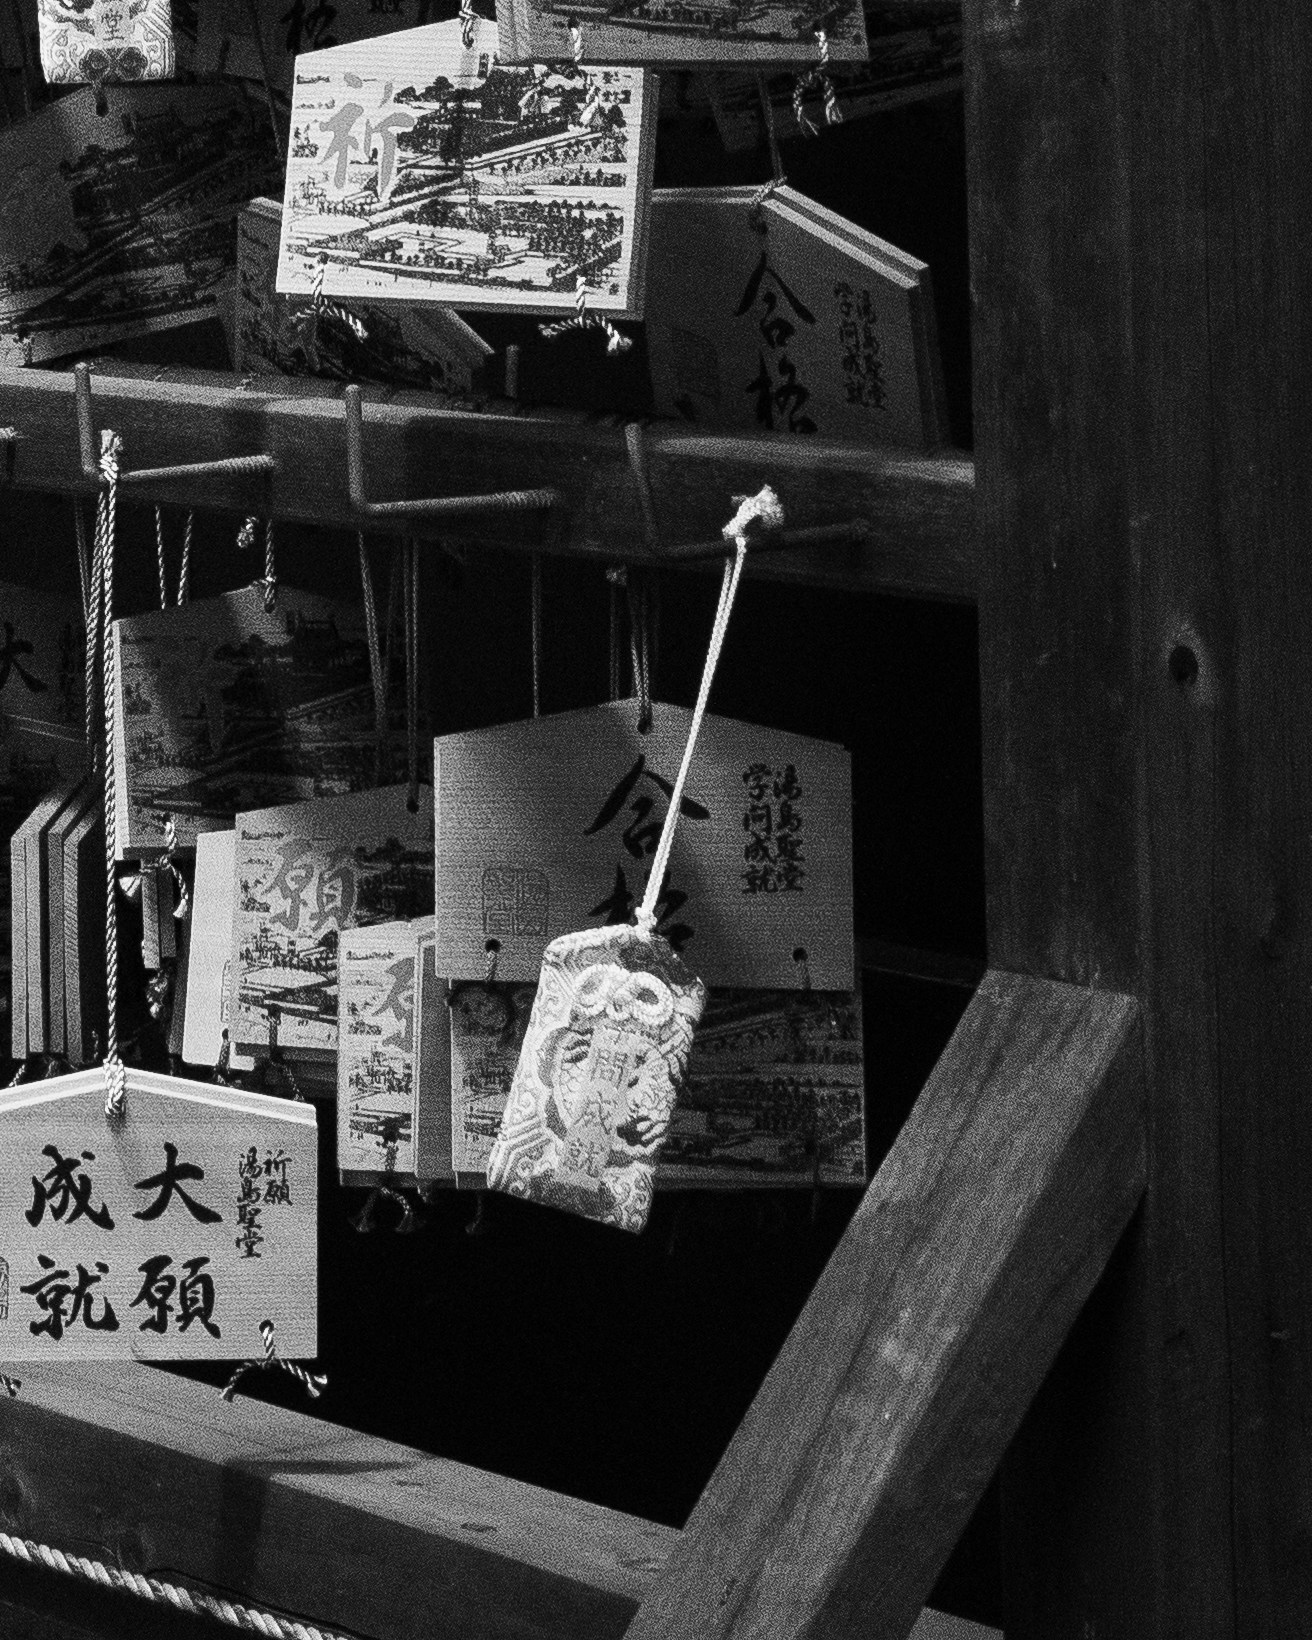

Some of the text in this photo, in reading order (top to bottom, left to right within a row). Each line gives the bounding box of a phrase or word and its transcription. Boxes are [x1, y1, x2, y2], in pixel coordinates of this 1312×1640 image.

[734, 251, 819, 435] 合格
[584, 753, 711, 953] 合格
[741, 762, 774, 896] 学問成就
[772, 764, 805, 894] 湯島聖堂
[19, 1143, 120, 1341] 成就
[128, 1141, 224, 1340] 大願
[234, 1145, 264, 1260] 湯島聖堂
[262, 1148, 293, 1207] 祈願
